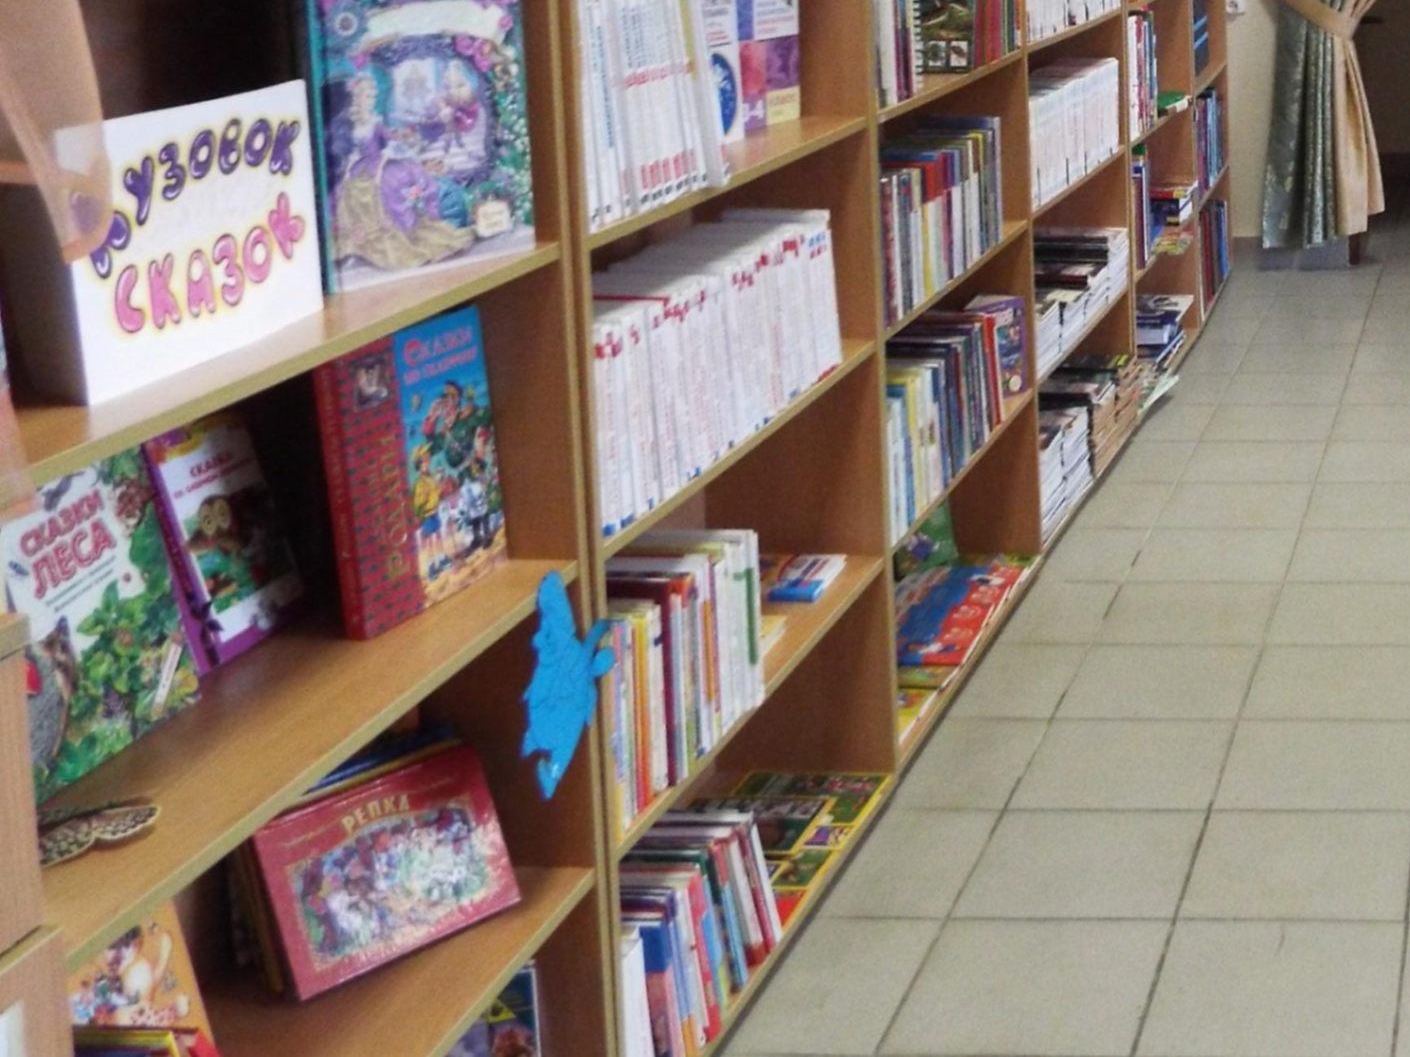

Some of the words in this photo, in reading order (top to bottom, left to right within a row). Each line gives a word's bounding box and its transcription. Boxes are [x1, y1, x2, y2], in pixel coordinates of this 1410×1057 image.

[18, 488, 105, 559] СКАЗКИ
[32, 517, 118, 600] ЛЕСА
[341, 792, 411, 835] РЕПКА
